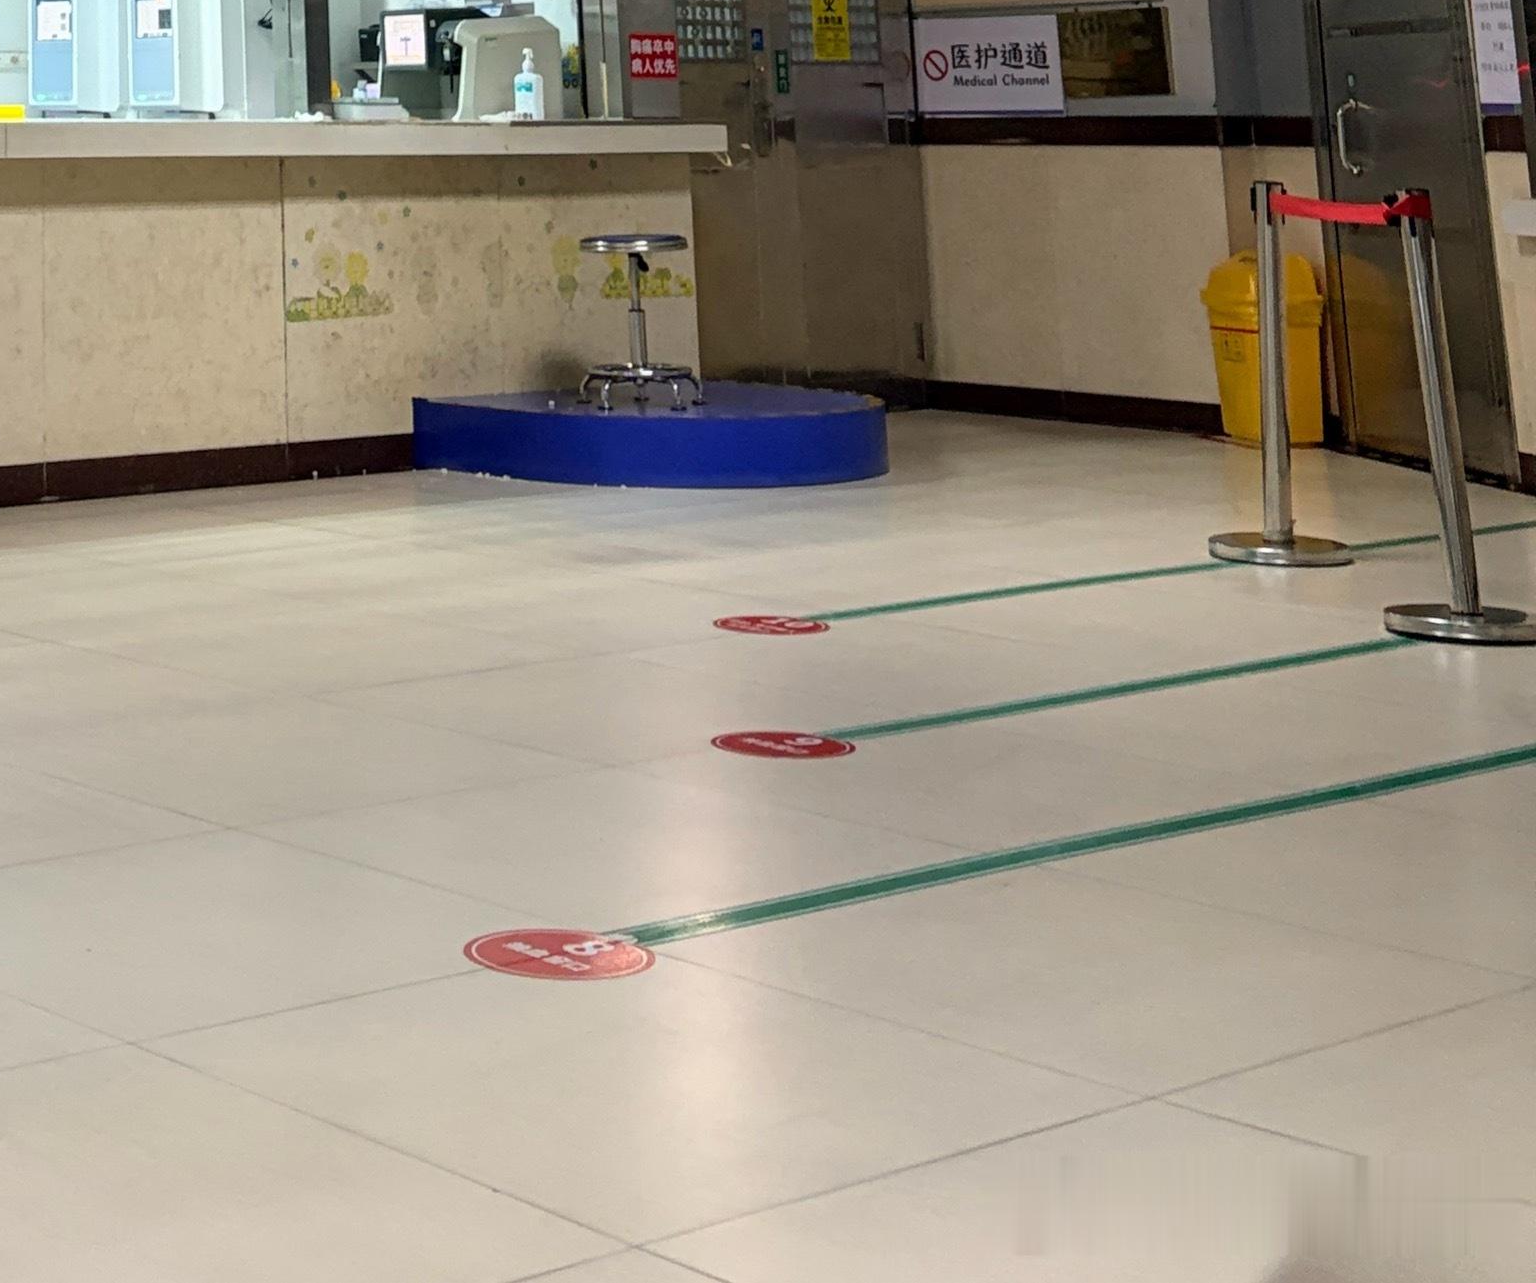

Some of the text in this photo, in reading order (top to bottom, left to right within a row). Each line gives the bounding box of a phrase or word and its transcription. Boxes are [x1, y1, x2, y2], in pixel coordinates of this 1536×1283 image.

[630, 38, 675, 55] 胸痛卒中
[951, 41, 1050, 70] 医护通道
[631, 58, 676, 74] 病人优先
[953, 73, 1050, 87] Medical Channel
